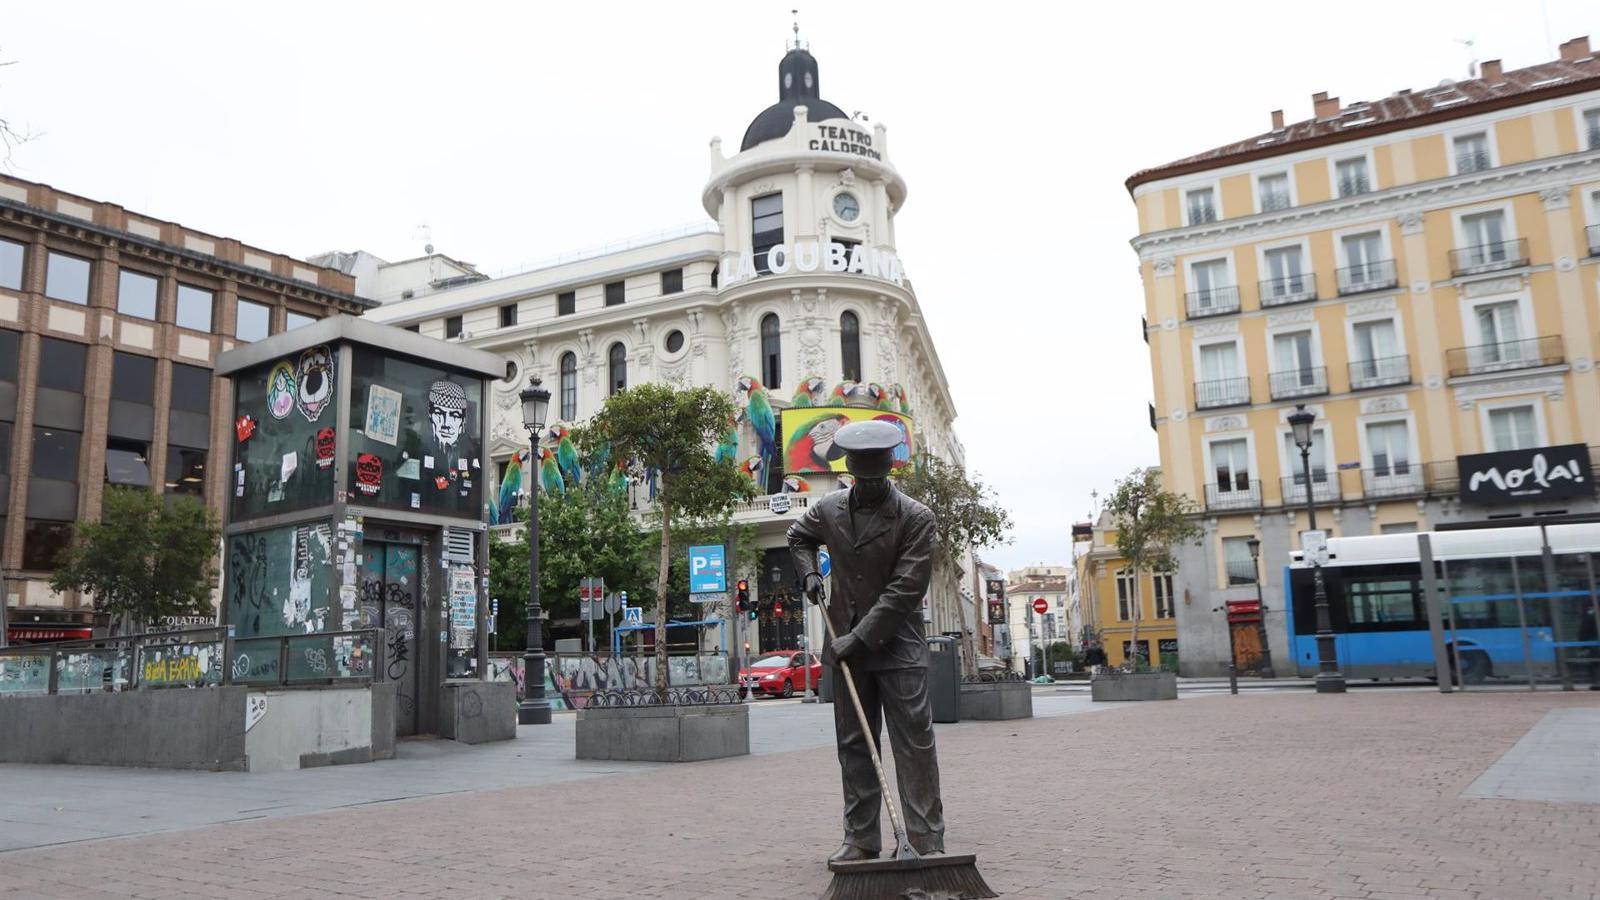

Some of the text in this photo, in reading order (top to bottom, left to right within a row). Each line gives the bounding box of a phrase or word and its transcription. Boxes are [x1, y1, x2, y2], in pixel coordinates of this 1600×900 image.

[818, 125, 872, 147] TEATRO
[722, 242, 904, 288] LA CUBANA
[692, 556, 707, 576] P
